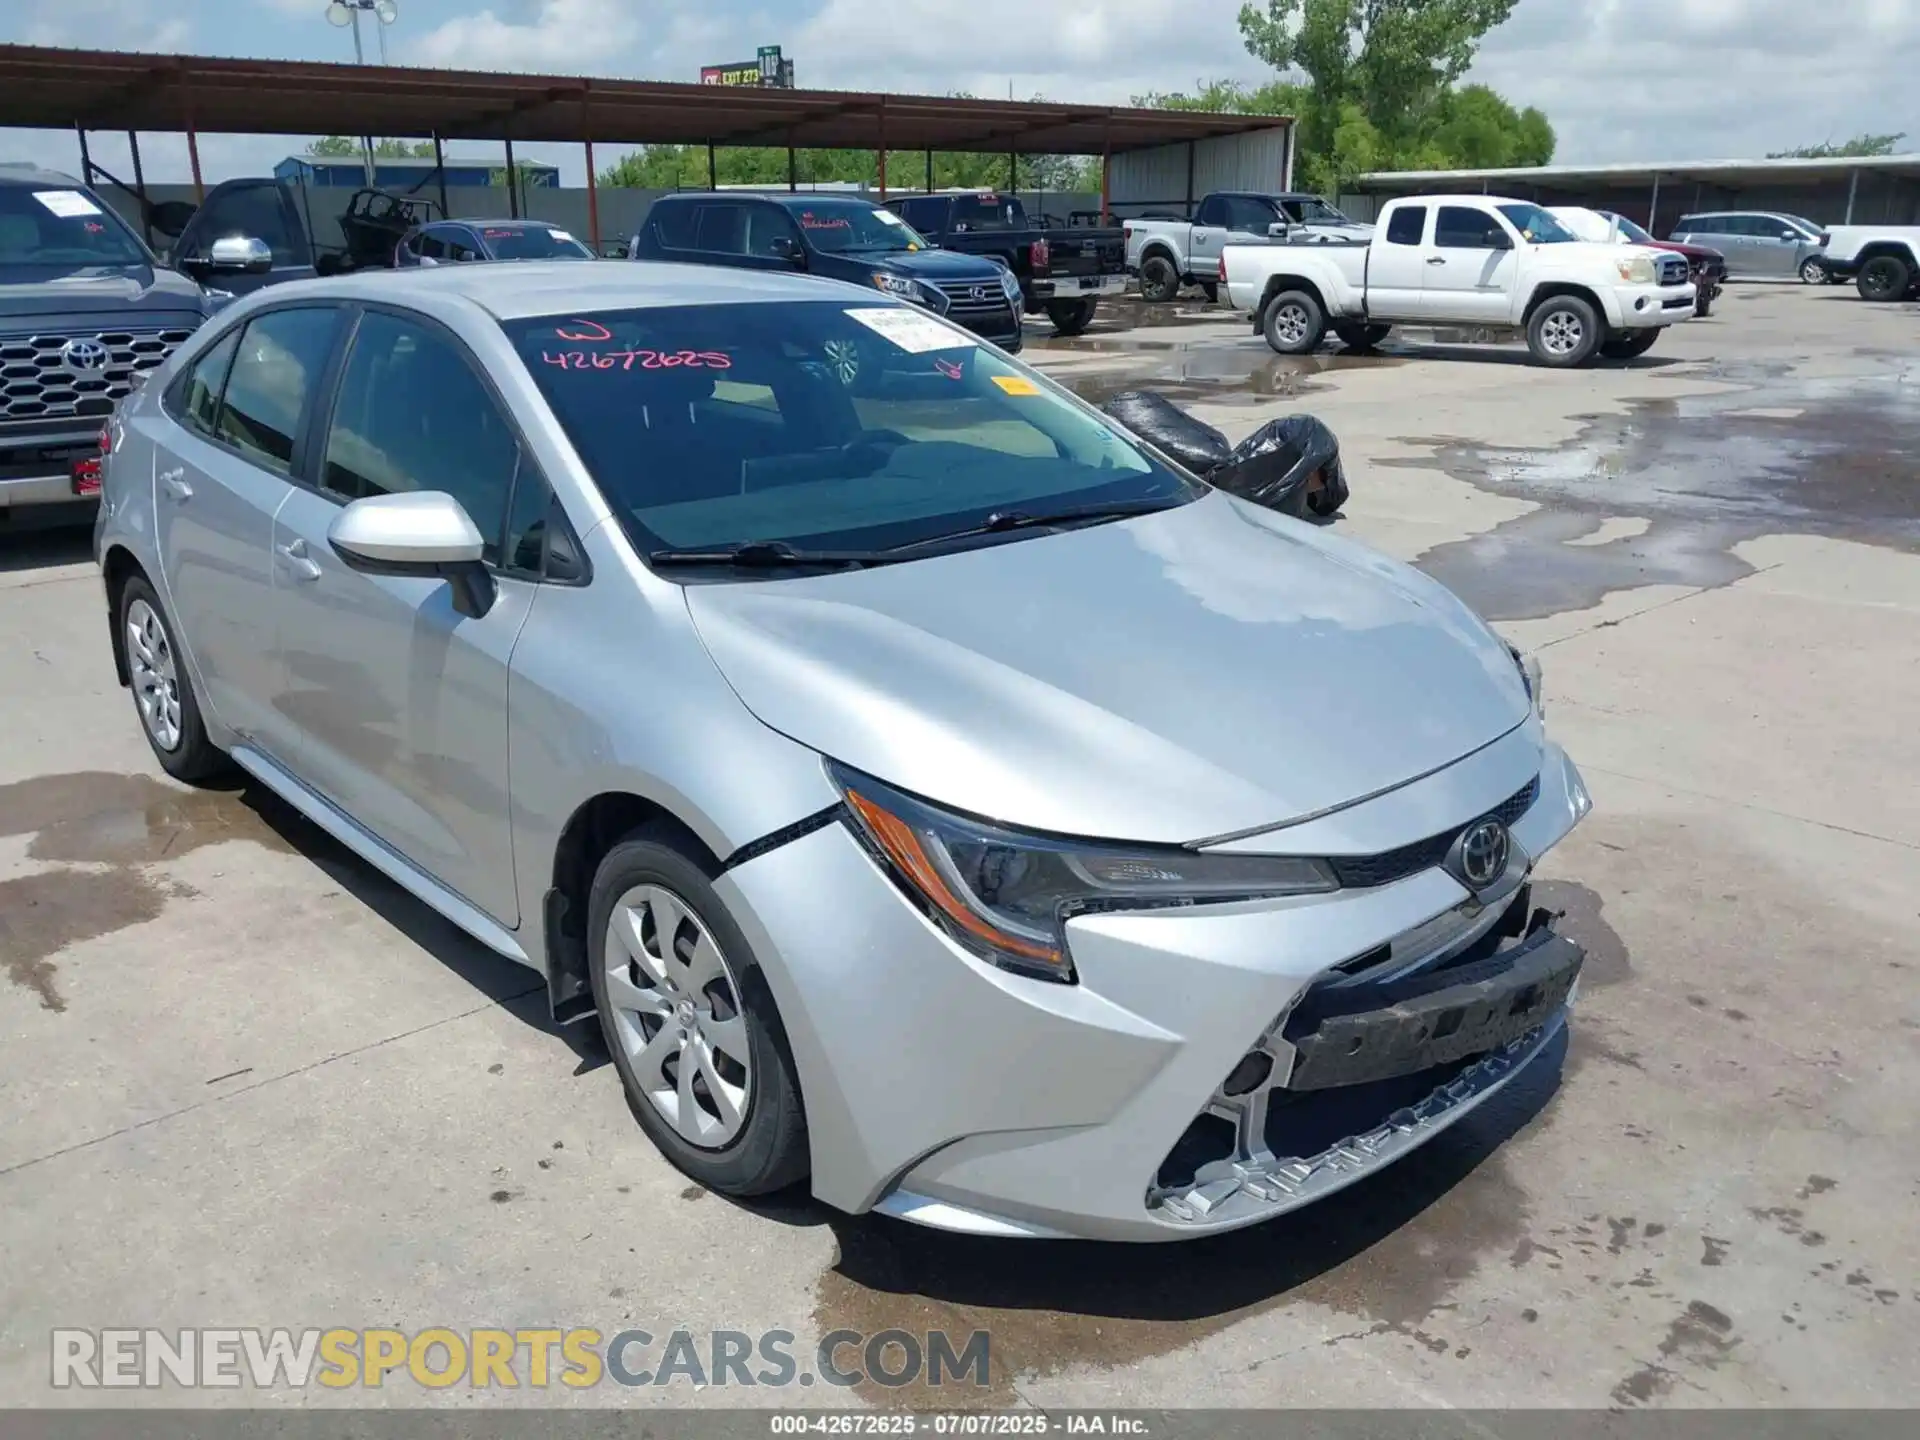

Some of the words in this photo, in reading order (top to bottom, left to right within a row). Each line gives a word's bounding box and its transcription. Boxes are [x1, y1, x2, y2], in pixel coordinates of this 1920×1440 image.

[722, 71, 741, 85] EXIT
[743, 69, 759, 83] 273
[541, 349, 732, 371] 42672625
